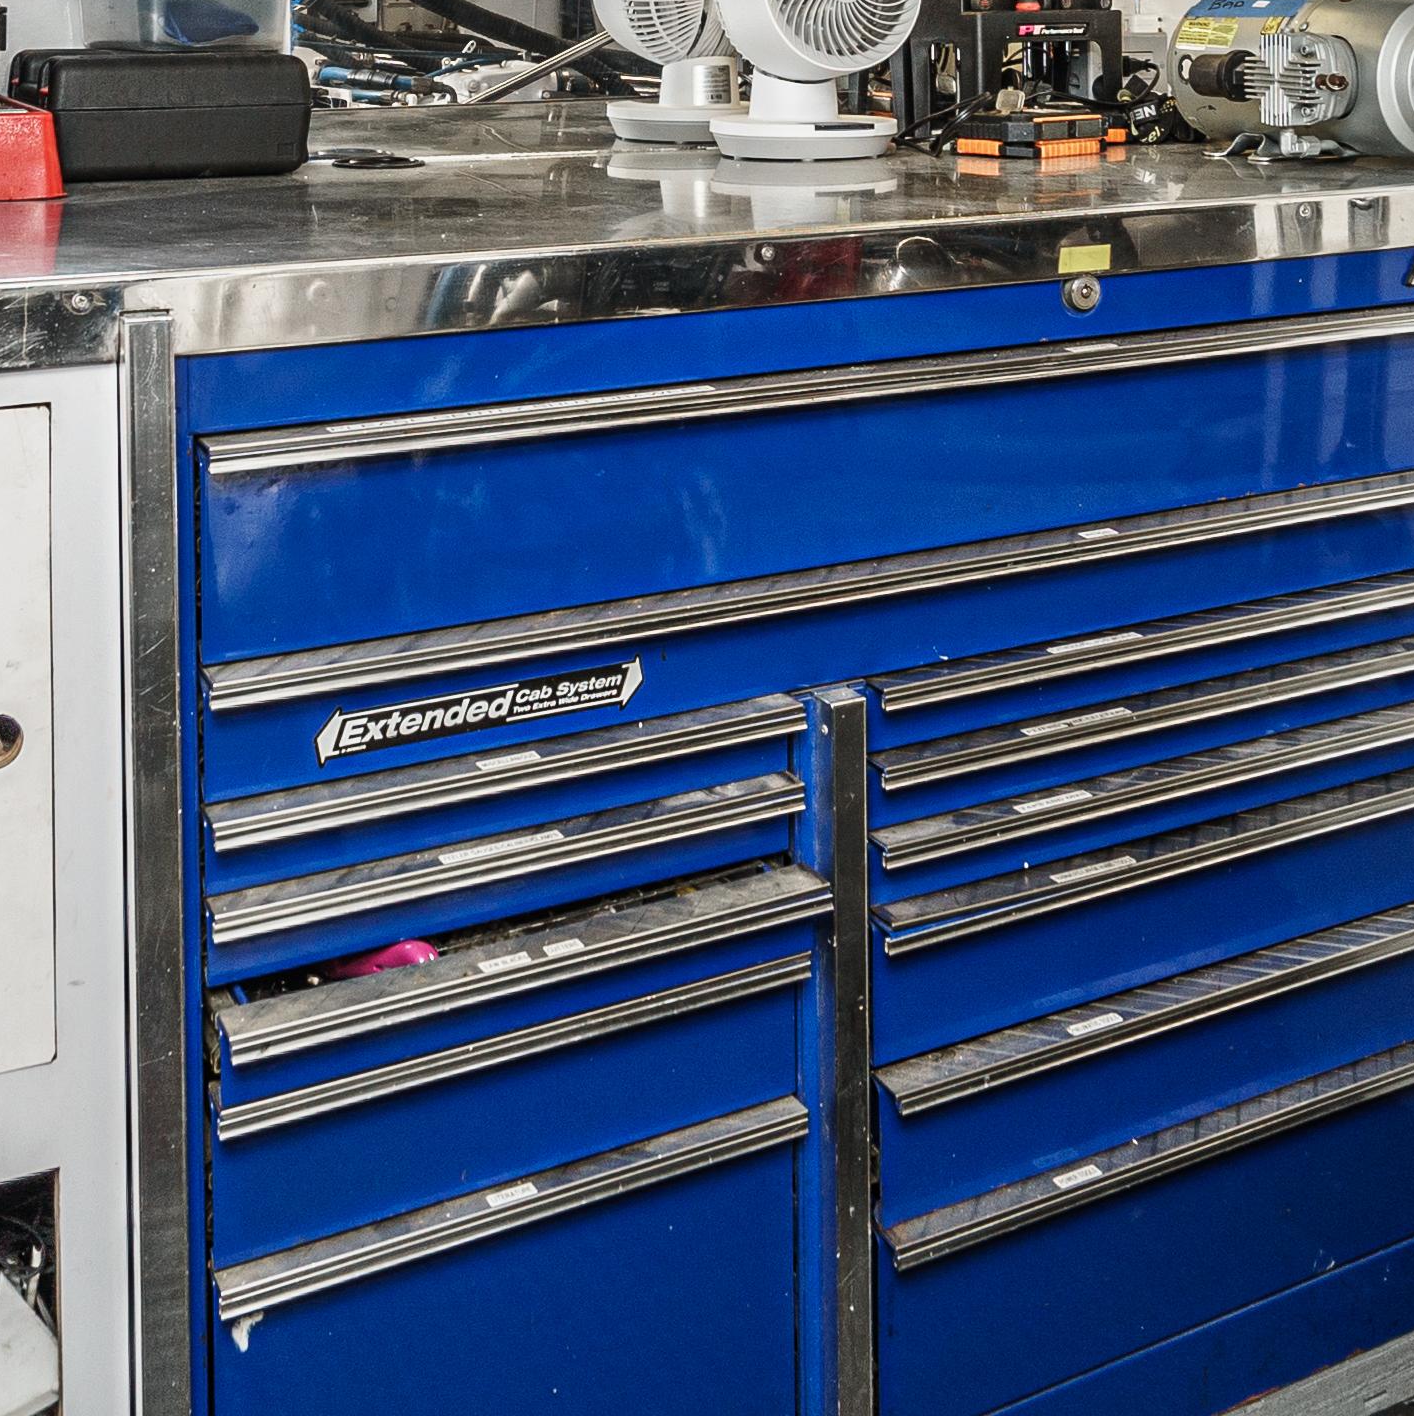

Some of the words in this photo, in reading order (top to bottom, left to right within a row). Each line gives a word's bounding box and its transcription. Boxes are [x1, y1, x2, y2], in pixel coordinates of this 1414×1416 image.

[337, 688, 514, 748] Extended
[515, 684, 553, 704] Cab
[555, 673, 623, 697] System
[513, 704, 531, 715] Two
[532, 699, 556, 711] Extra
